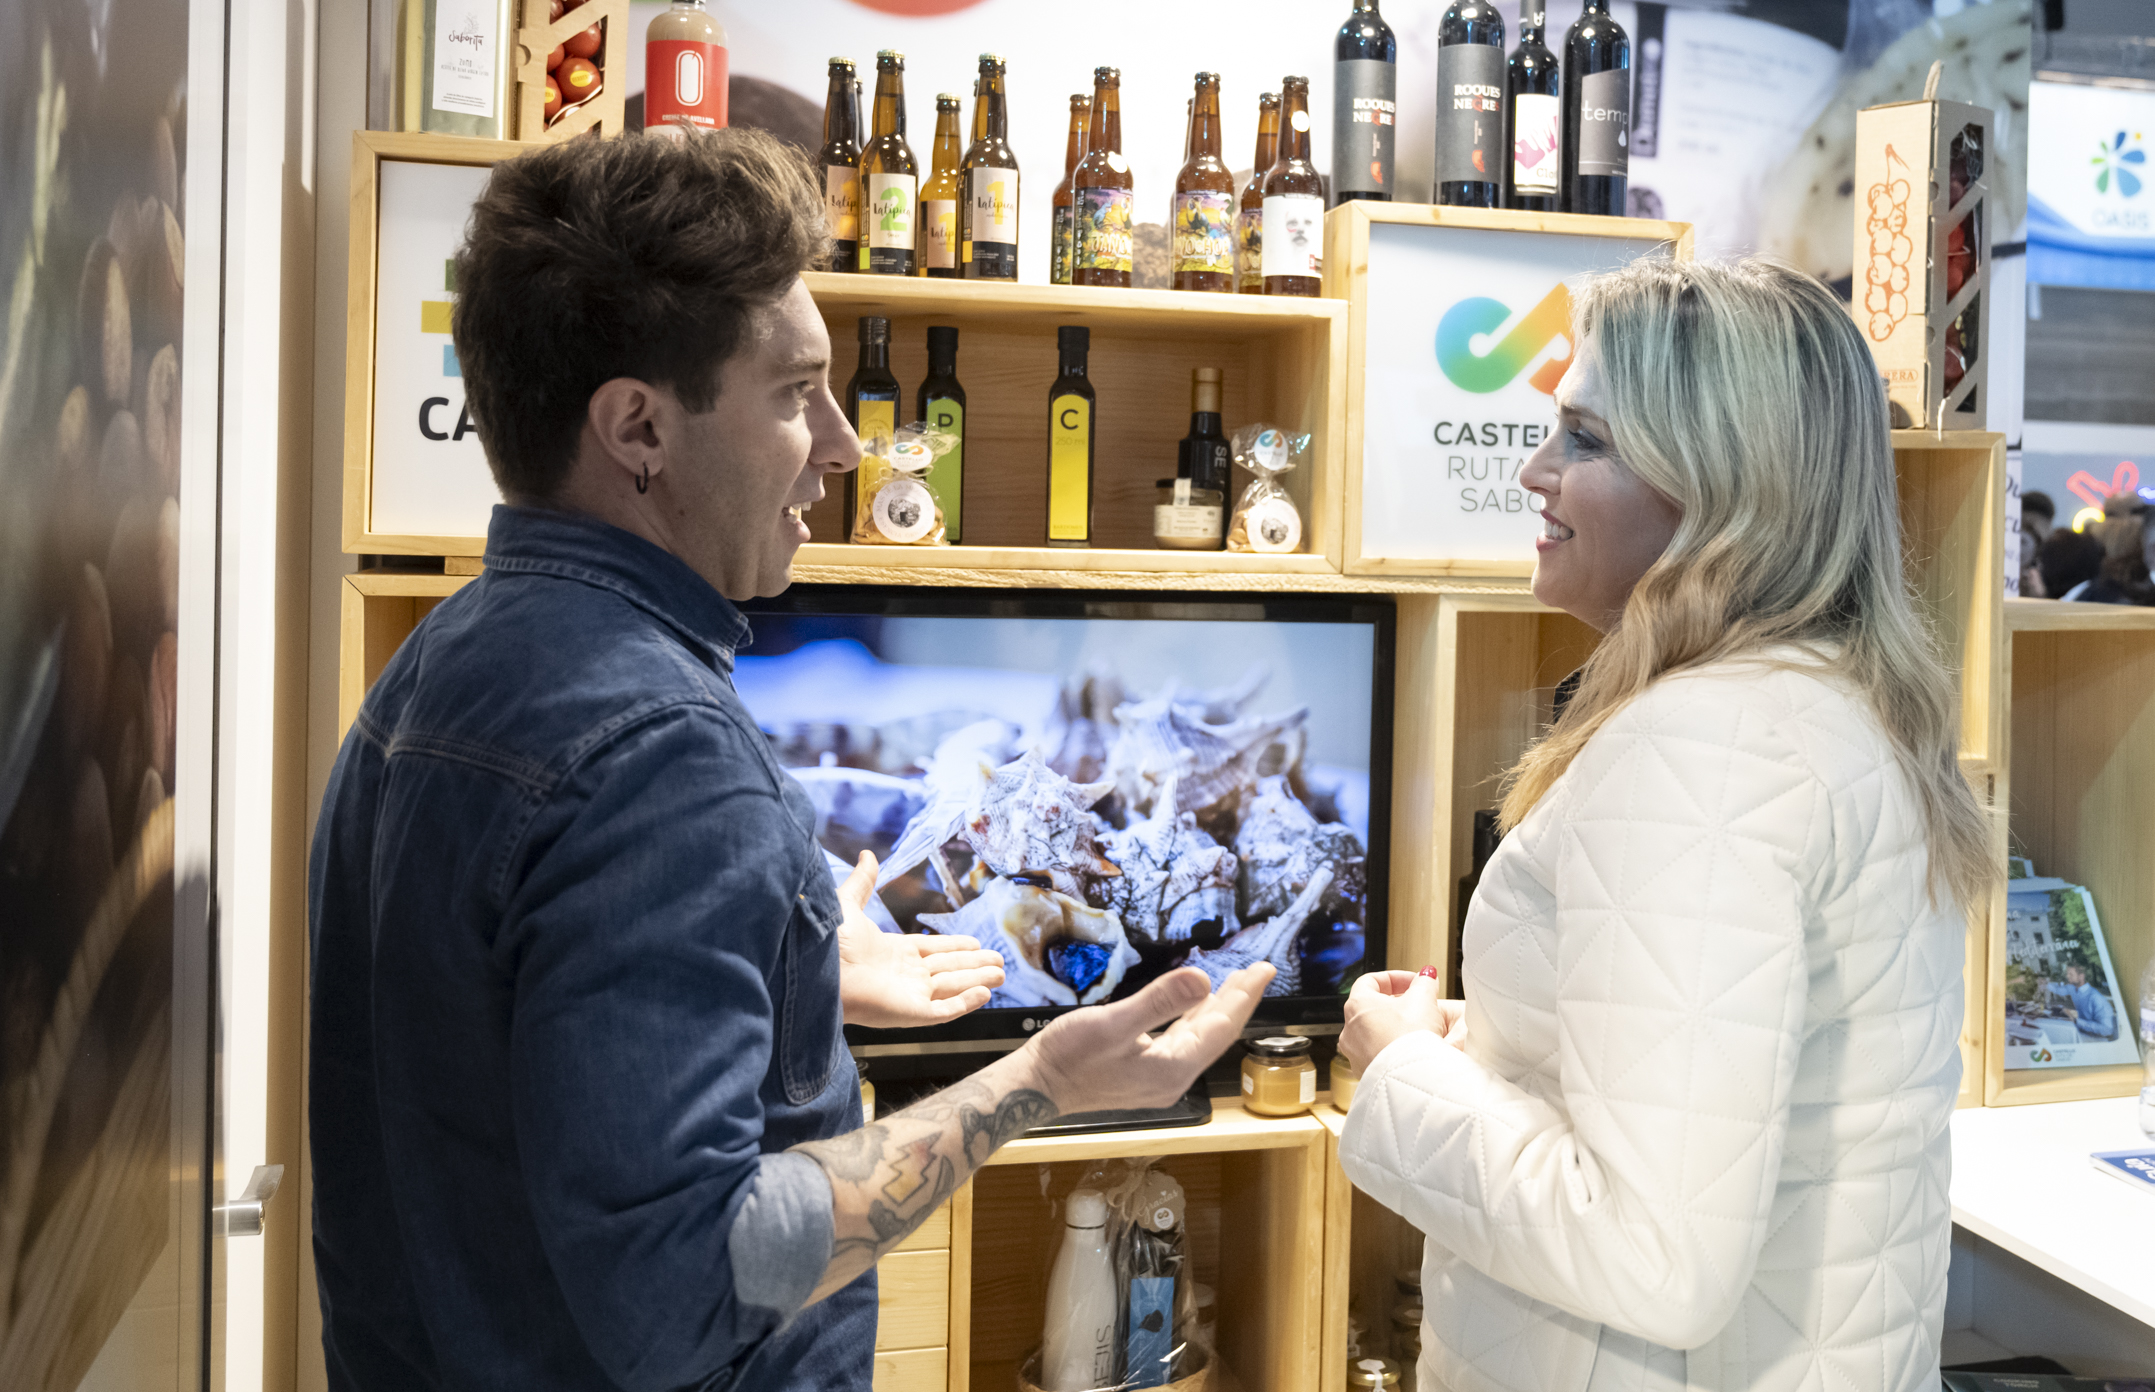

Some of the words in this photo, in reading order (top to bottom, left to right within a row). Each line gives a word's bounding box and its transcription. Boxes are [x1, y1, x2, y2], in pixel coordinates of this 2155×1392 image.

[1454, 84, 1501, 99] ROQUES
[1353, 98, 1396, 114] ROQUES
[1454, 98, 1500, 112] NEGRES
[938, 413, 954, 428] D
[1060, 409, 1079, 430] C
